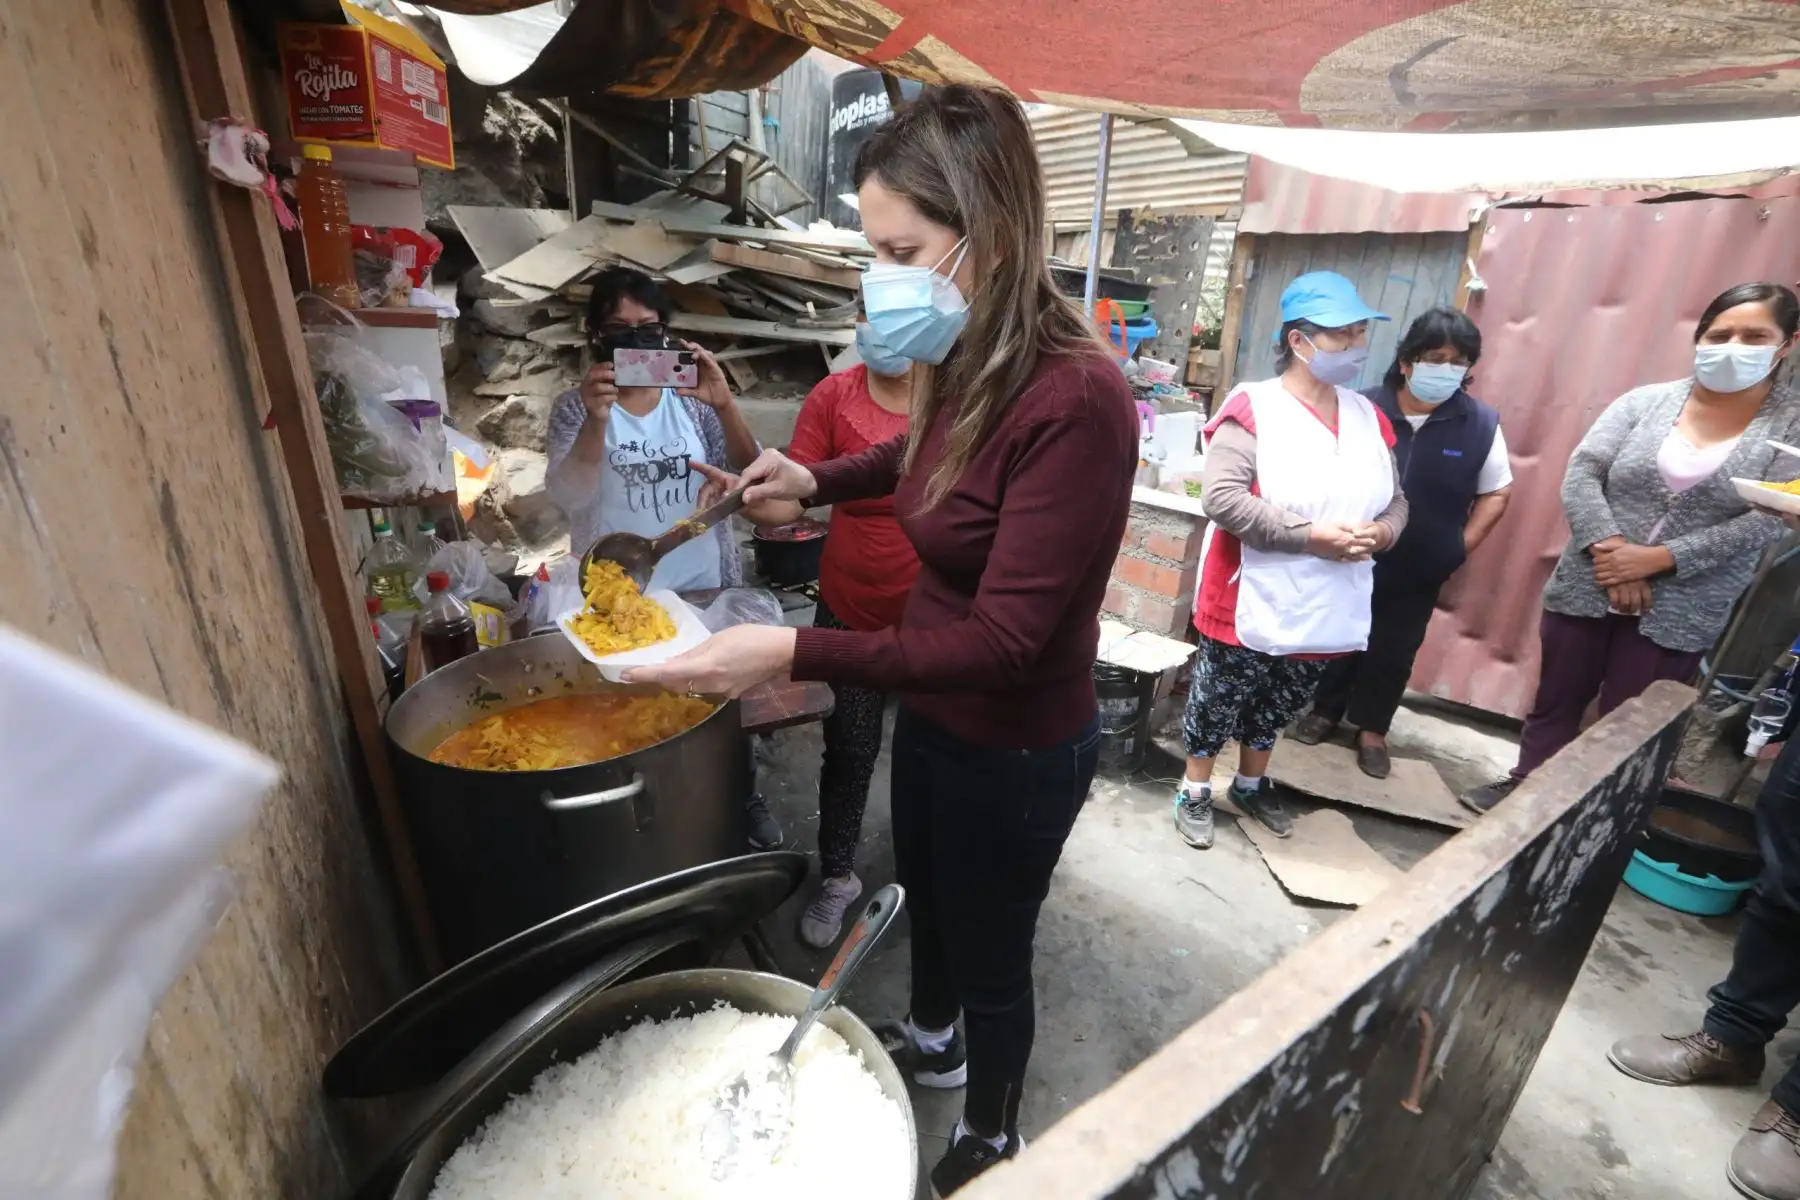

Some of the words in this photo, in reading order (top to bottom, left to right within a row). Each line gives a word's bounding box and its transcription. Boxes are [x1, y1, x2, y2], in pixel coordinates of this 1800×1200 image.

[304, 52, 322, 70] La
[295, 64, 357, 101] Rojita
[329, 105, 364, 114] TOMATES
[611, 452, 692, 487] YOU
[626, 471, 697, 523] tiful
